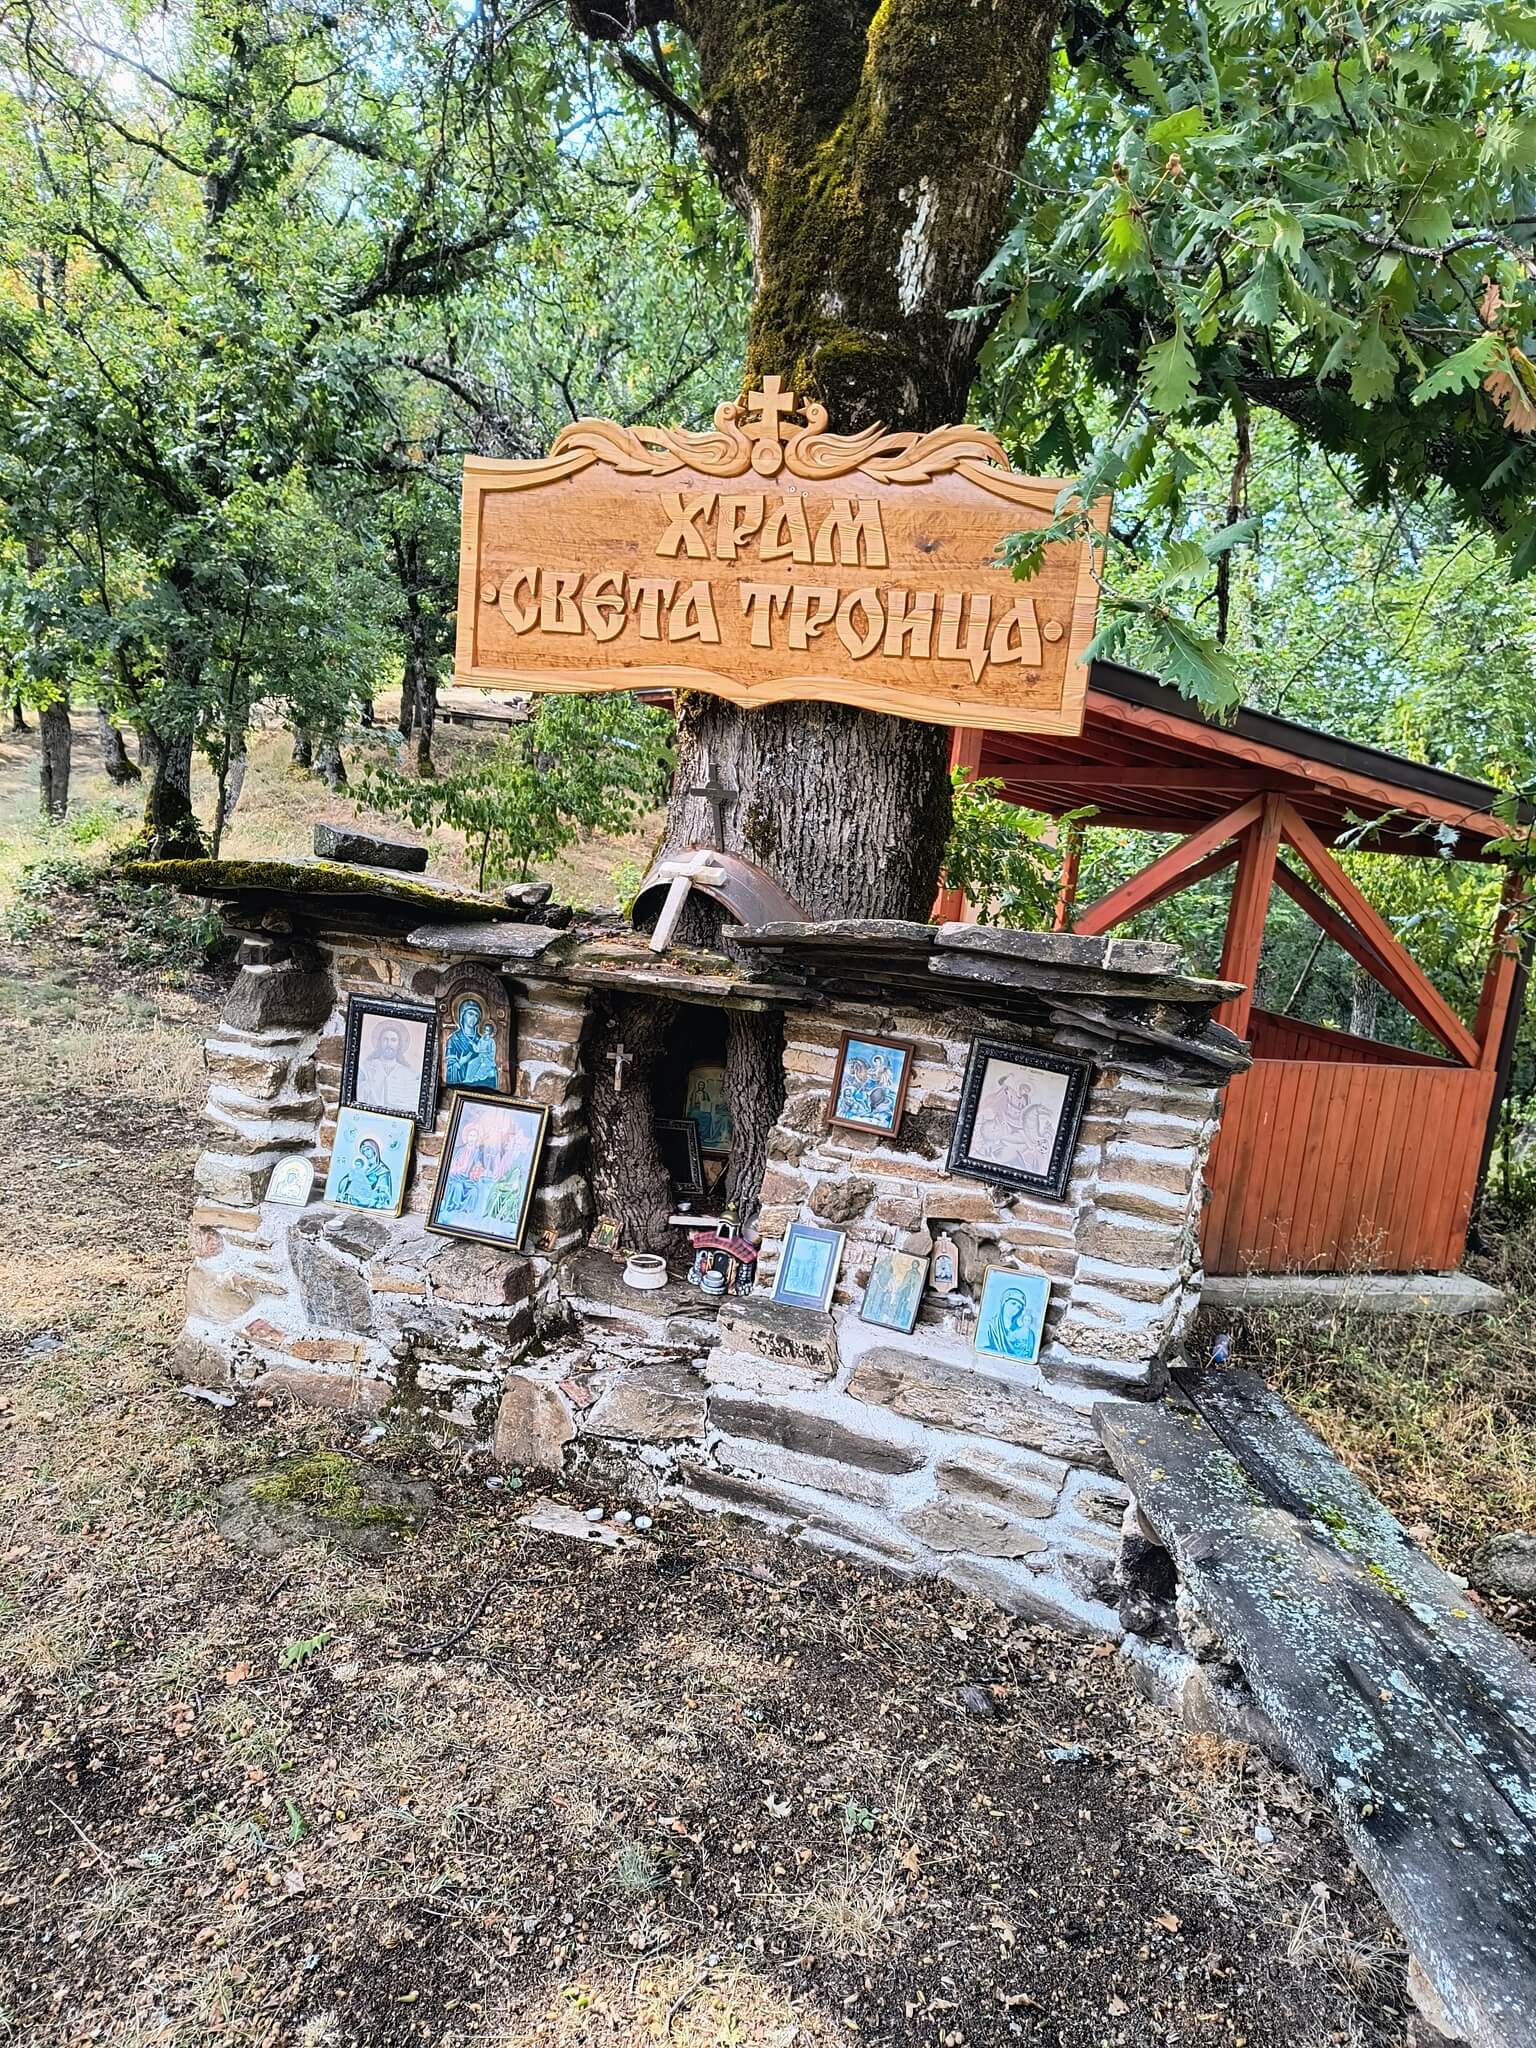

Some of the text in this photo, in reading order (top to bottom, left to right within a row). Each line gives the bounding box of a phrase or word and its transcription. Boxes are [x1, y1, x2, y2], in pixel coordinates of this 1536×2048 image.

[656, 493, 889, 569] ХРАМ
[499, 567, 1043, 684] СВЕТА ТРОИЦА
